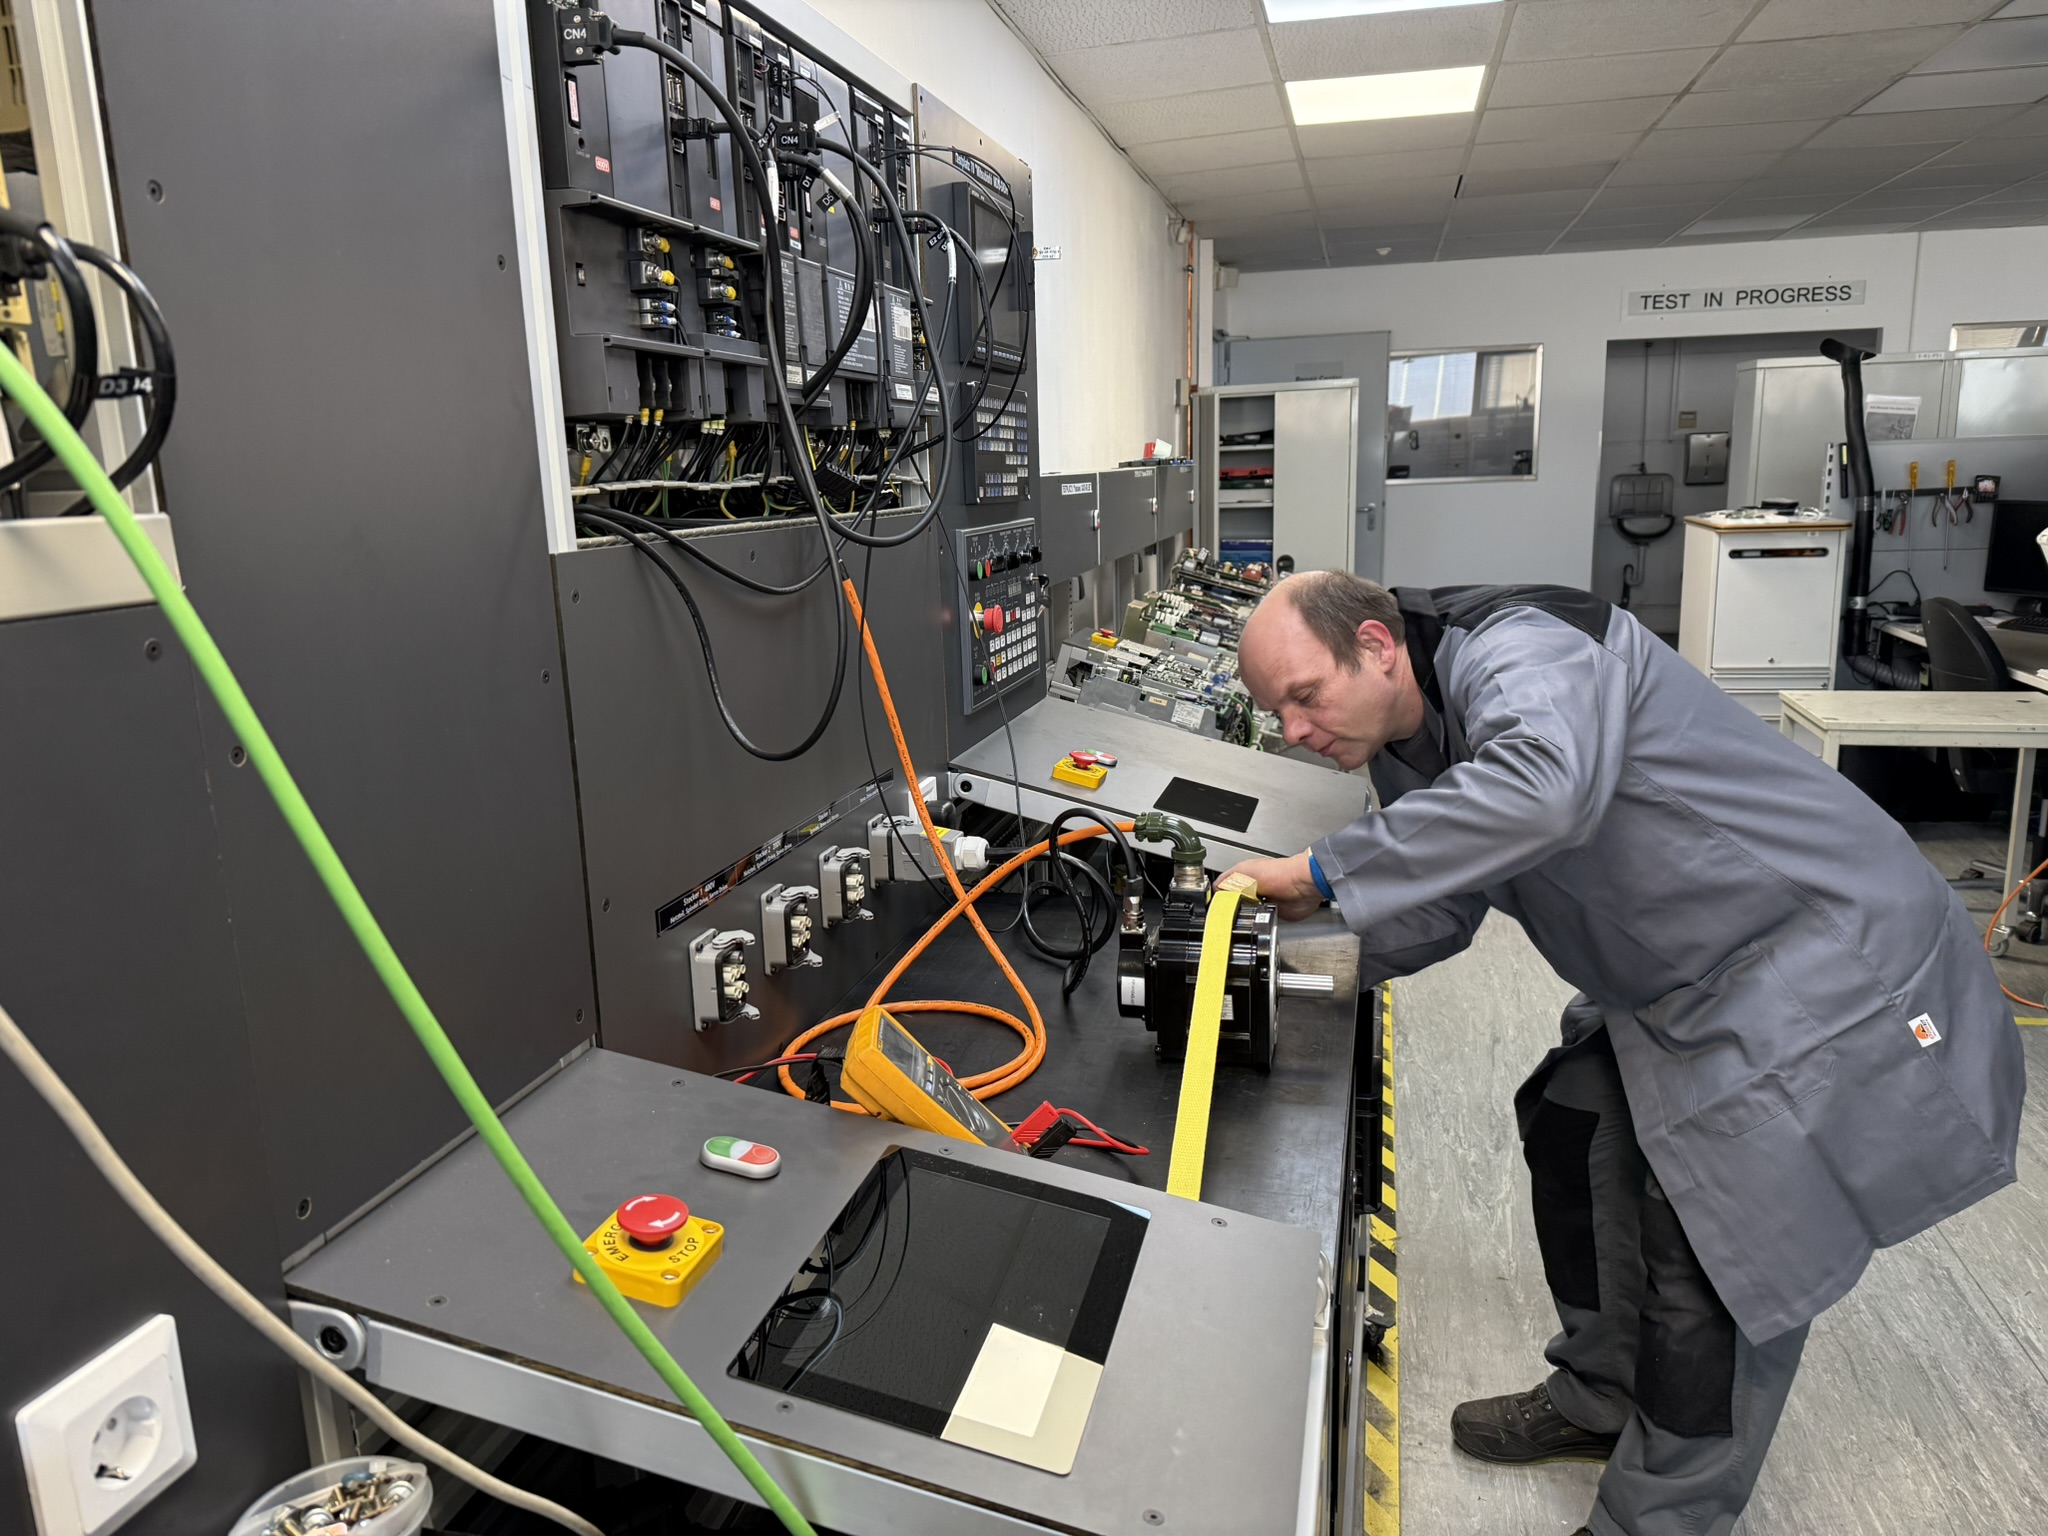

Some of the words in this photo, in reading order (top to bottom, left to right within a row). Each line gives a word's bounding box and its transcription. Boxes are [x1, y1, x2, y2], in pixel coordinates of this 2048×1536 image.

[563, 28, 587, 40] CN4
[781, 135, 799, 145] CN4
[802, 175, 813, 188] D1
[821, 194, 835, 206] D5
[1640, 293, 1691, 310] TEST
[1703, 291, 1723, 308] IN
[1735, 285, 1853, 306] PROGRESS
[99, 378, 129, 395] D3
[683, 891, 700, 906] Stecker
[699, 888, 703, 896] 1
[668, 1236, 699, 1264] STOP
